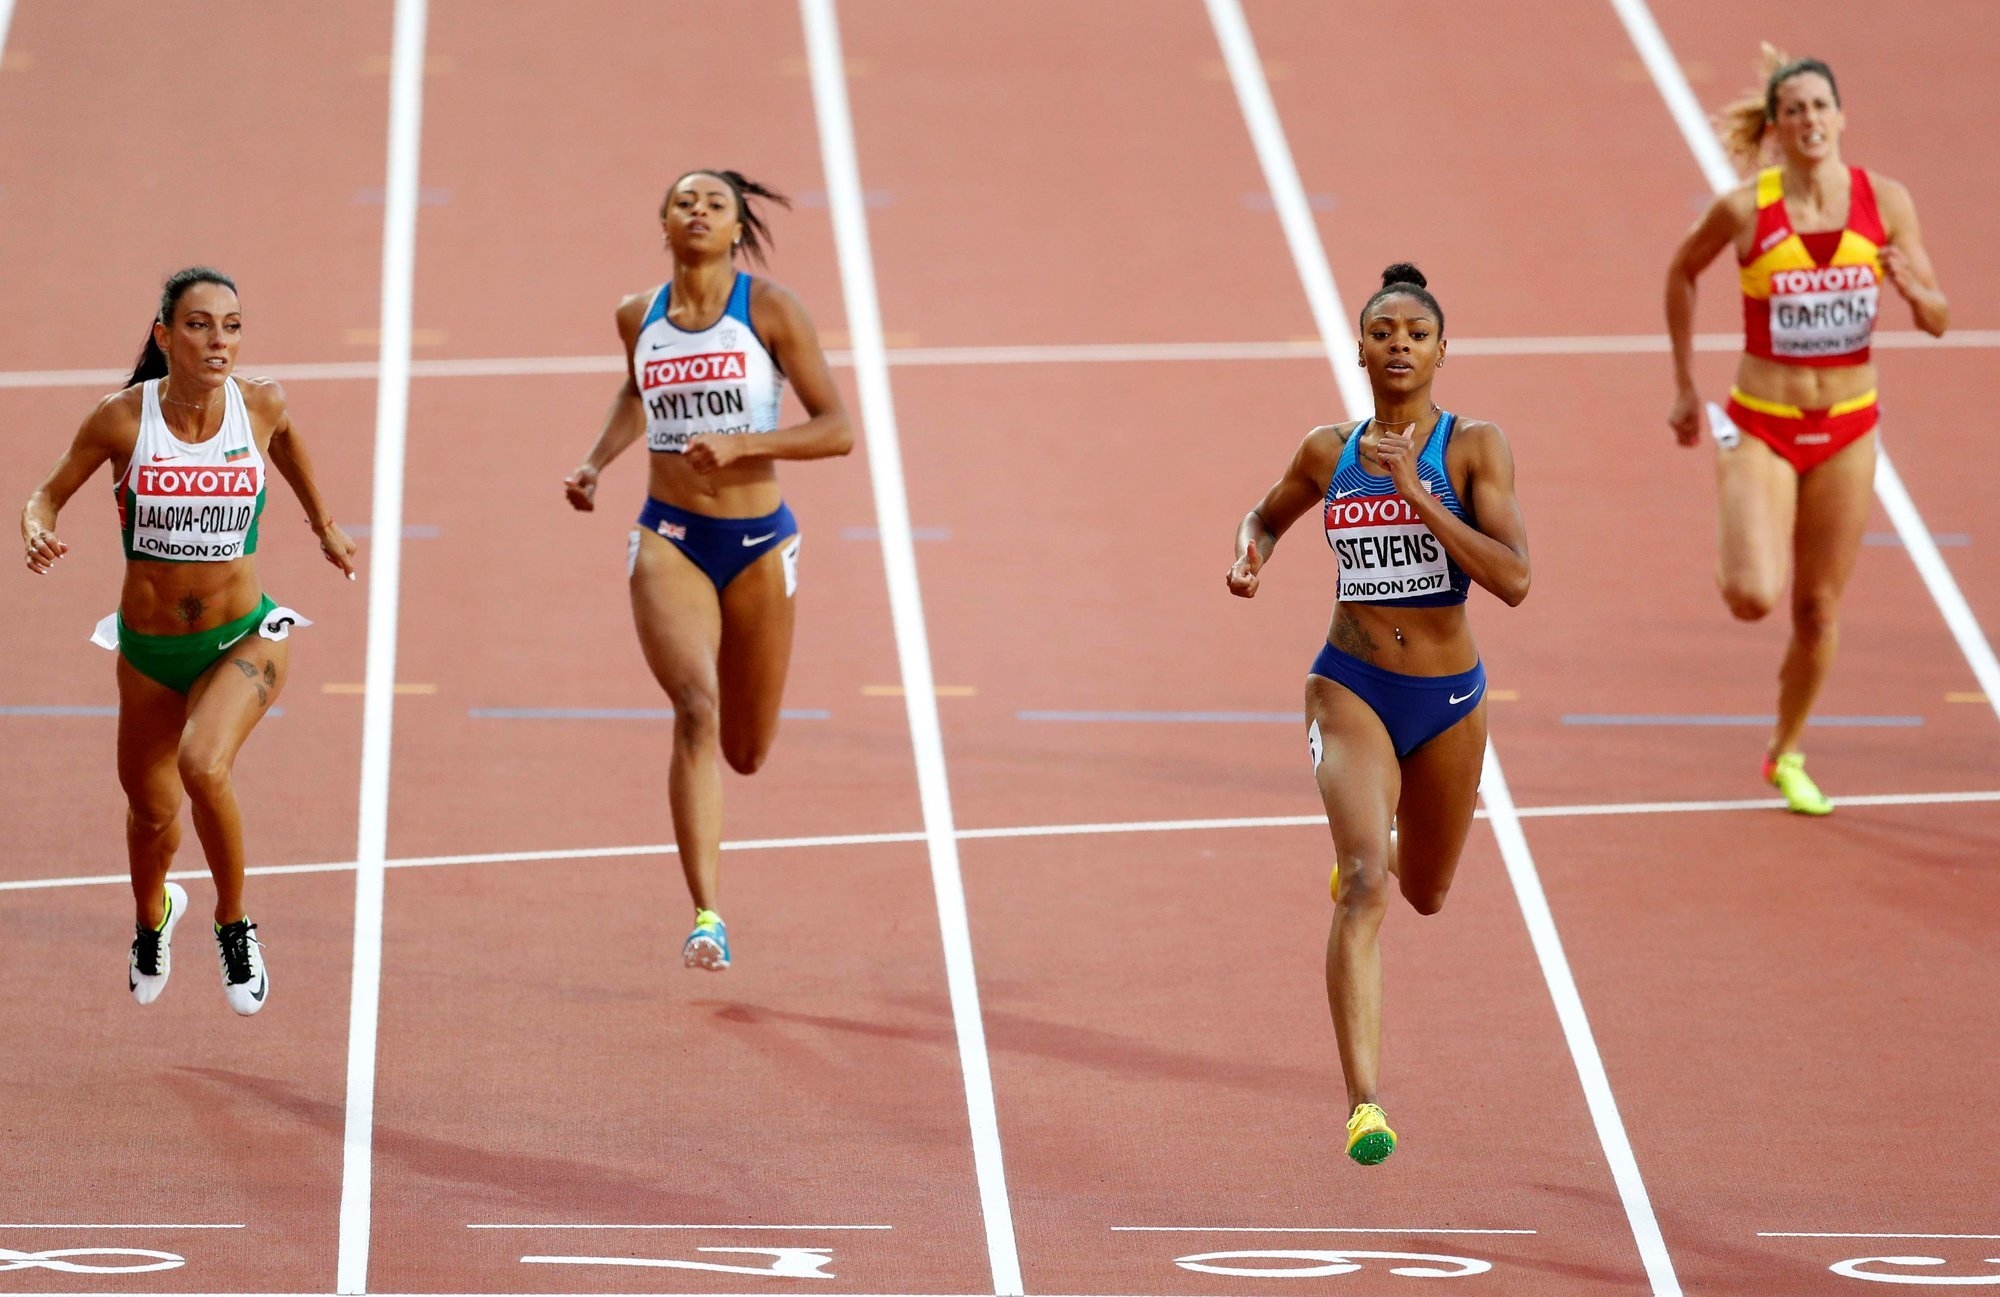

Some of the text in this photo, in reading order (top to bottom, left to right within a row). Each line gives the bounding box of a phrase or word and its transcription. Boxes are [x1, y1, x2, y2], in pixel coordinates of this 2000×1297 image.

[1772, 266, 1874, 293] TOYOTA
[647, 355, 743, 386] TOYOTA
[649, 388, 744, 420] HYLTON
[142, 470, 253, 493] TOYOTA
[138, 505, 251, 534] LALOVA-COLLIO
[1331, 499, 1421, 525] TOYOT
[139, 536, 209, 557] LONDON
[1335, 533, 1439, 570] STEVENS
[1343, 574, 1445, 596] LONDON 2017
[1172, 1249, 1493, 1278] 6
